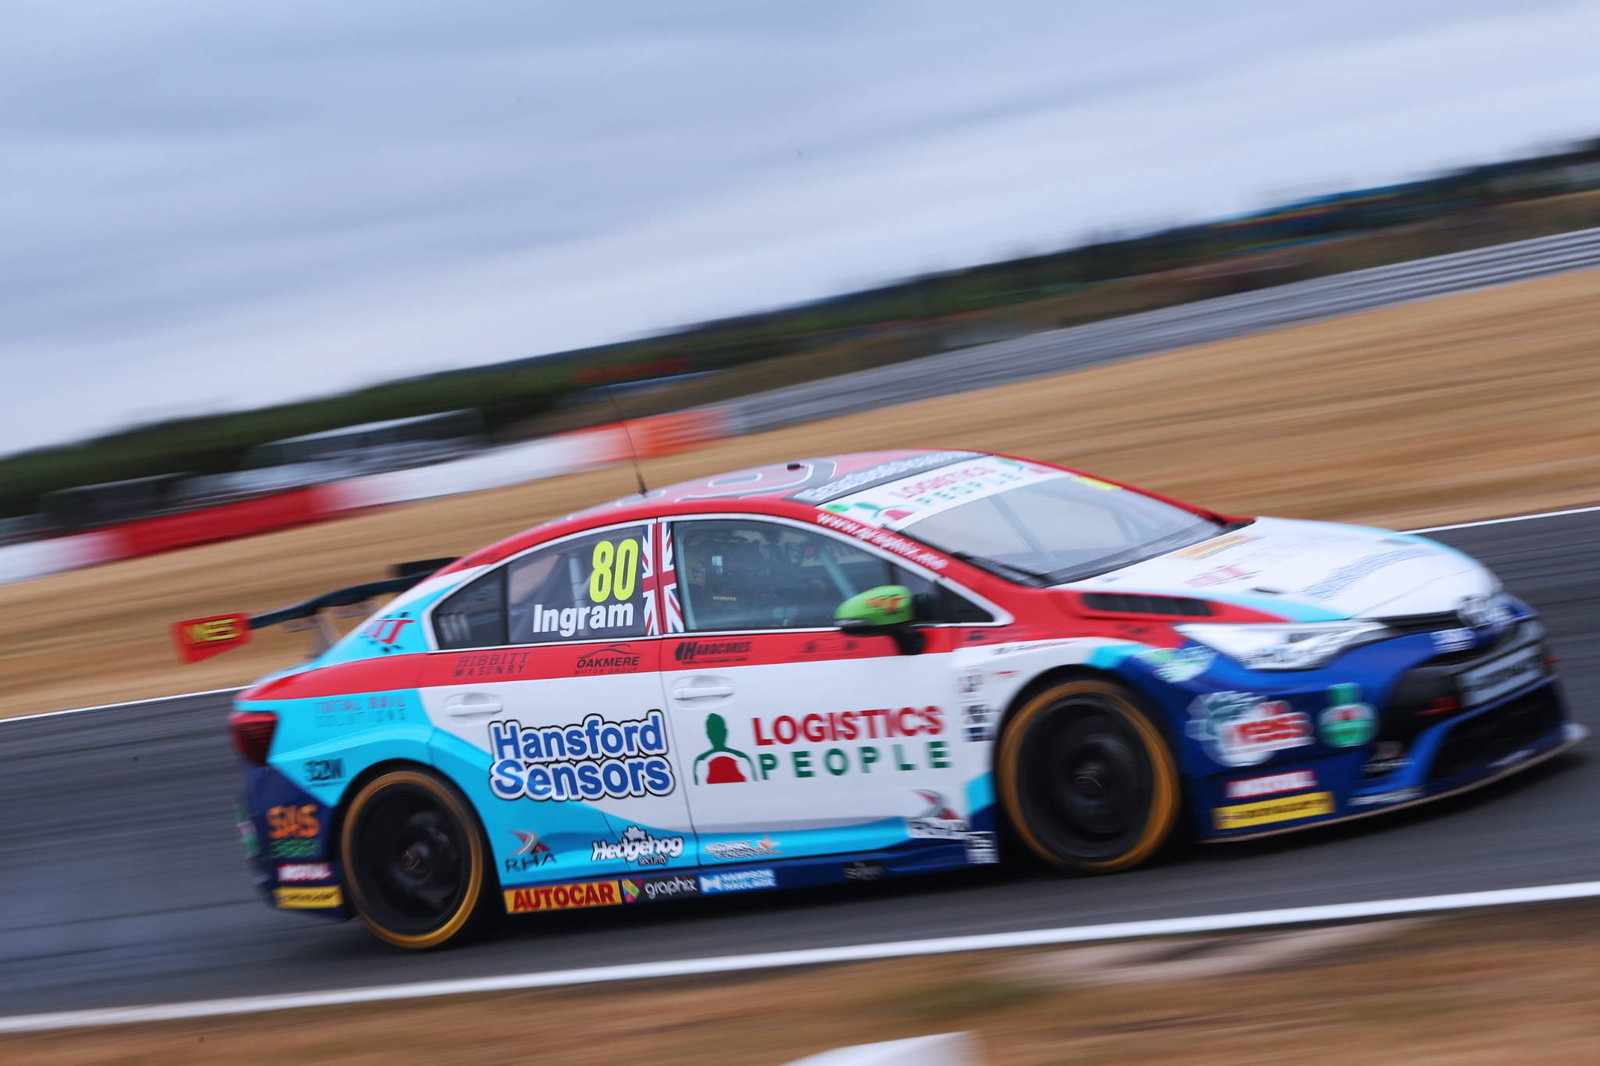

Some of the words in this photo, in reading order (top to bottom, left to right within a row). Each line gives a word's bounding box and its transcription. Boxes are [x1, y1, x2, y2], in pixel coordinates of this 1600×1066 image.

[589, 538, 639, 603] 80
[532, 602, 634, 637] Ingram
[457, 652, 530, 668] HIBBITT
[576, 656, 641, 668] OAKMERE
[491, 713, 665, 761] Hansford
[752, 706, 944, 746] LOGISTICS
[759, 741, 953, 780] PEOPLE
[493, 758, 671, 797] Sensors
[504, 854, 558, 873] RHA
[590, 835, 685, 863] Hedgehog
[512, 883, 614, 912] AUTOCAR
[644, 876, 698, 899] graphix
